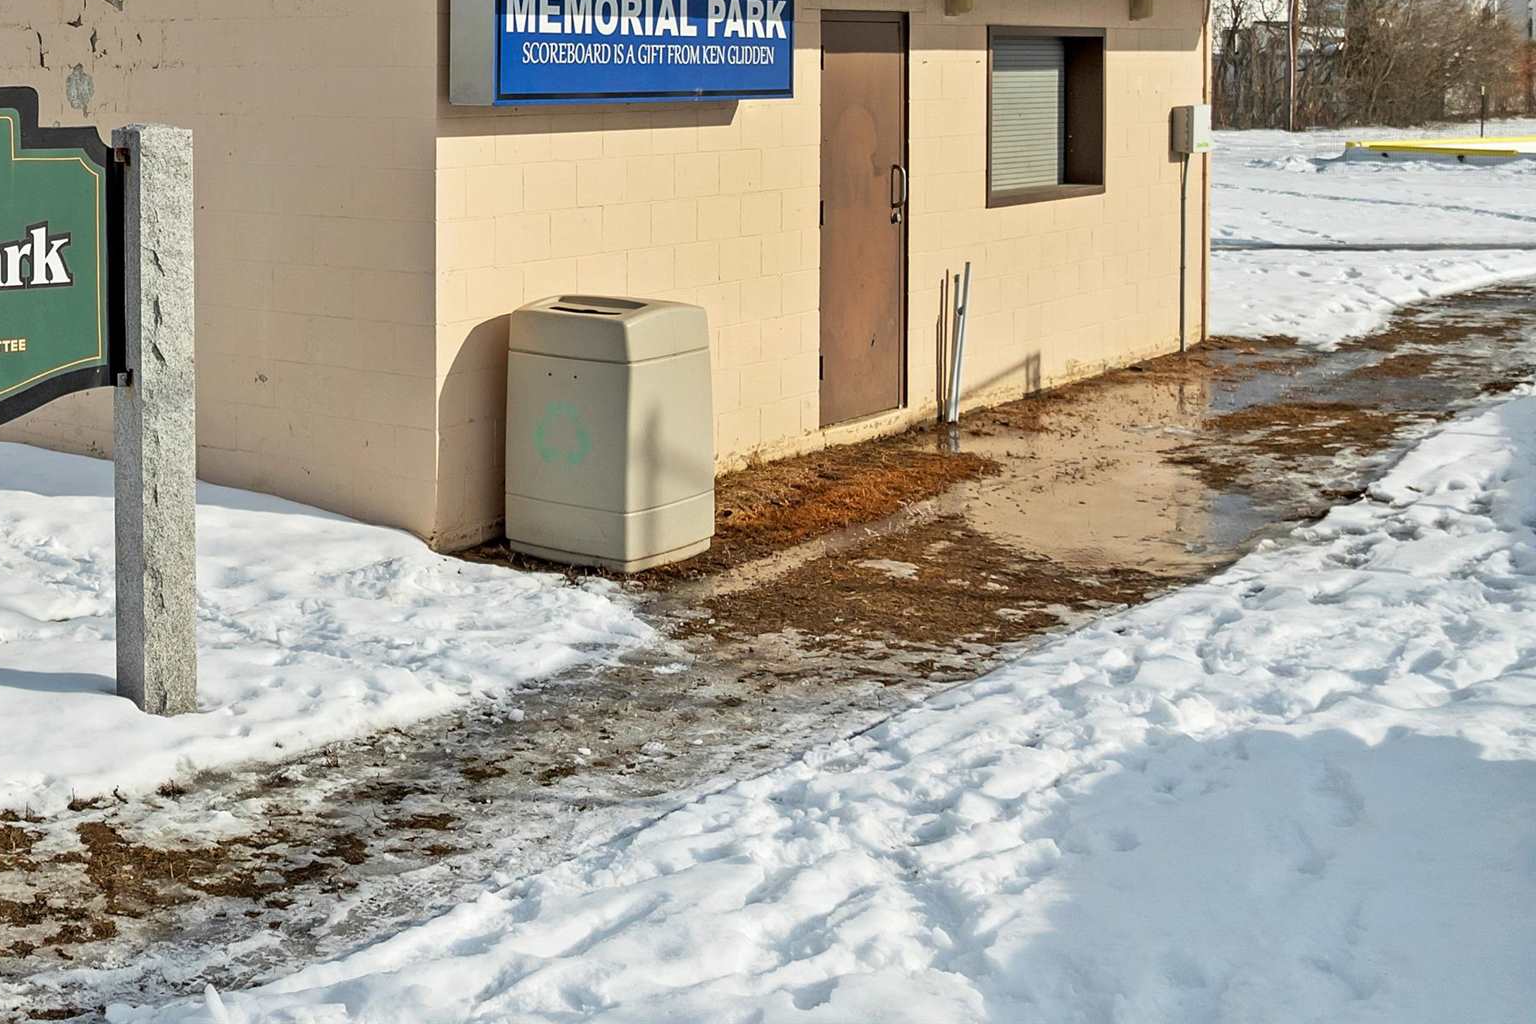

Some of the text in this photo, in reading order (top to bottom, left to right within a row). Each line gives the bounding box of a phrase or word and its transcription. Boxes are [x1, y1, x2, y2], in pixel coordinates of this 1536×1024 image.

[522, 41, 775, 65] SCOREBOARD IS A GIFT FROM KEN GLIDDEN
